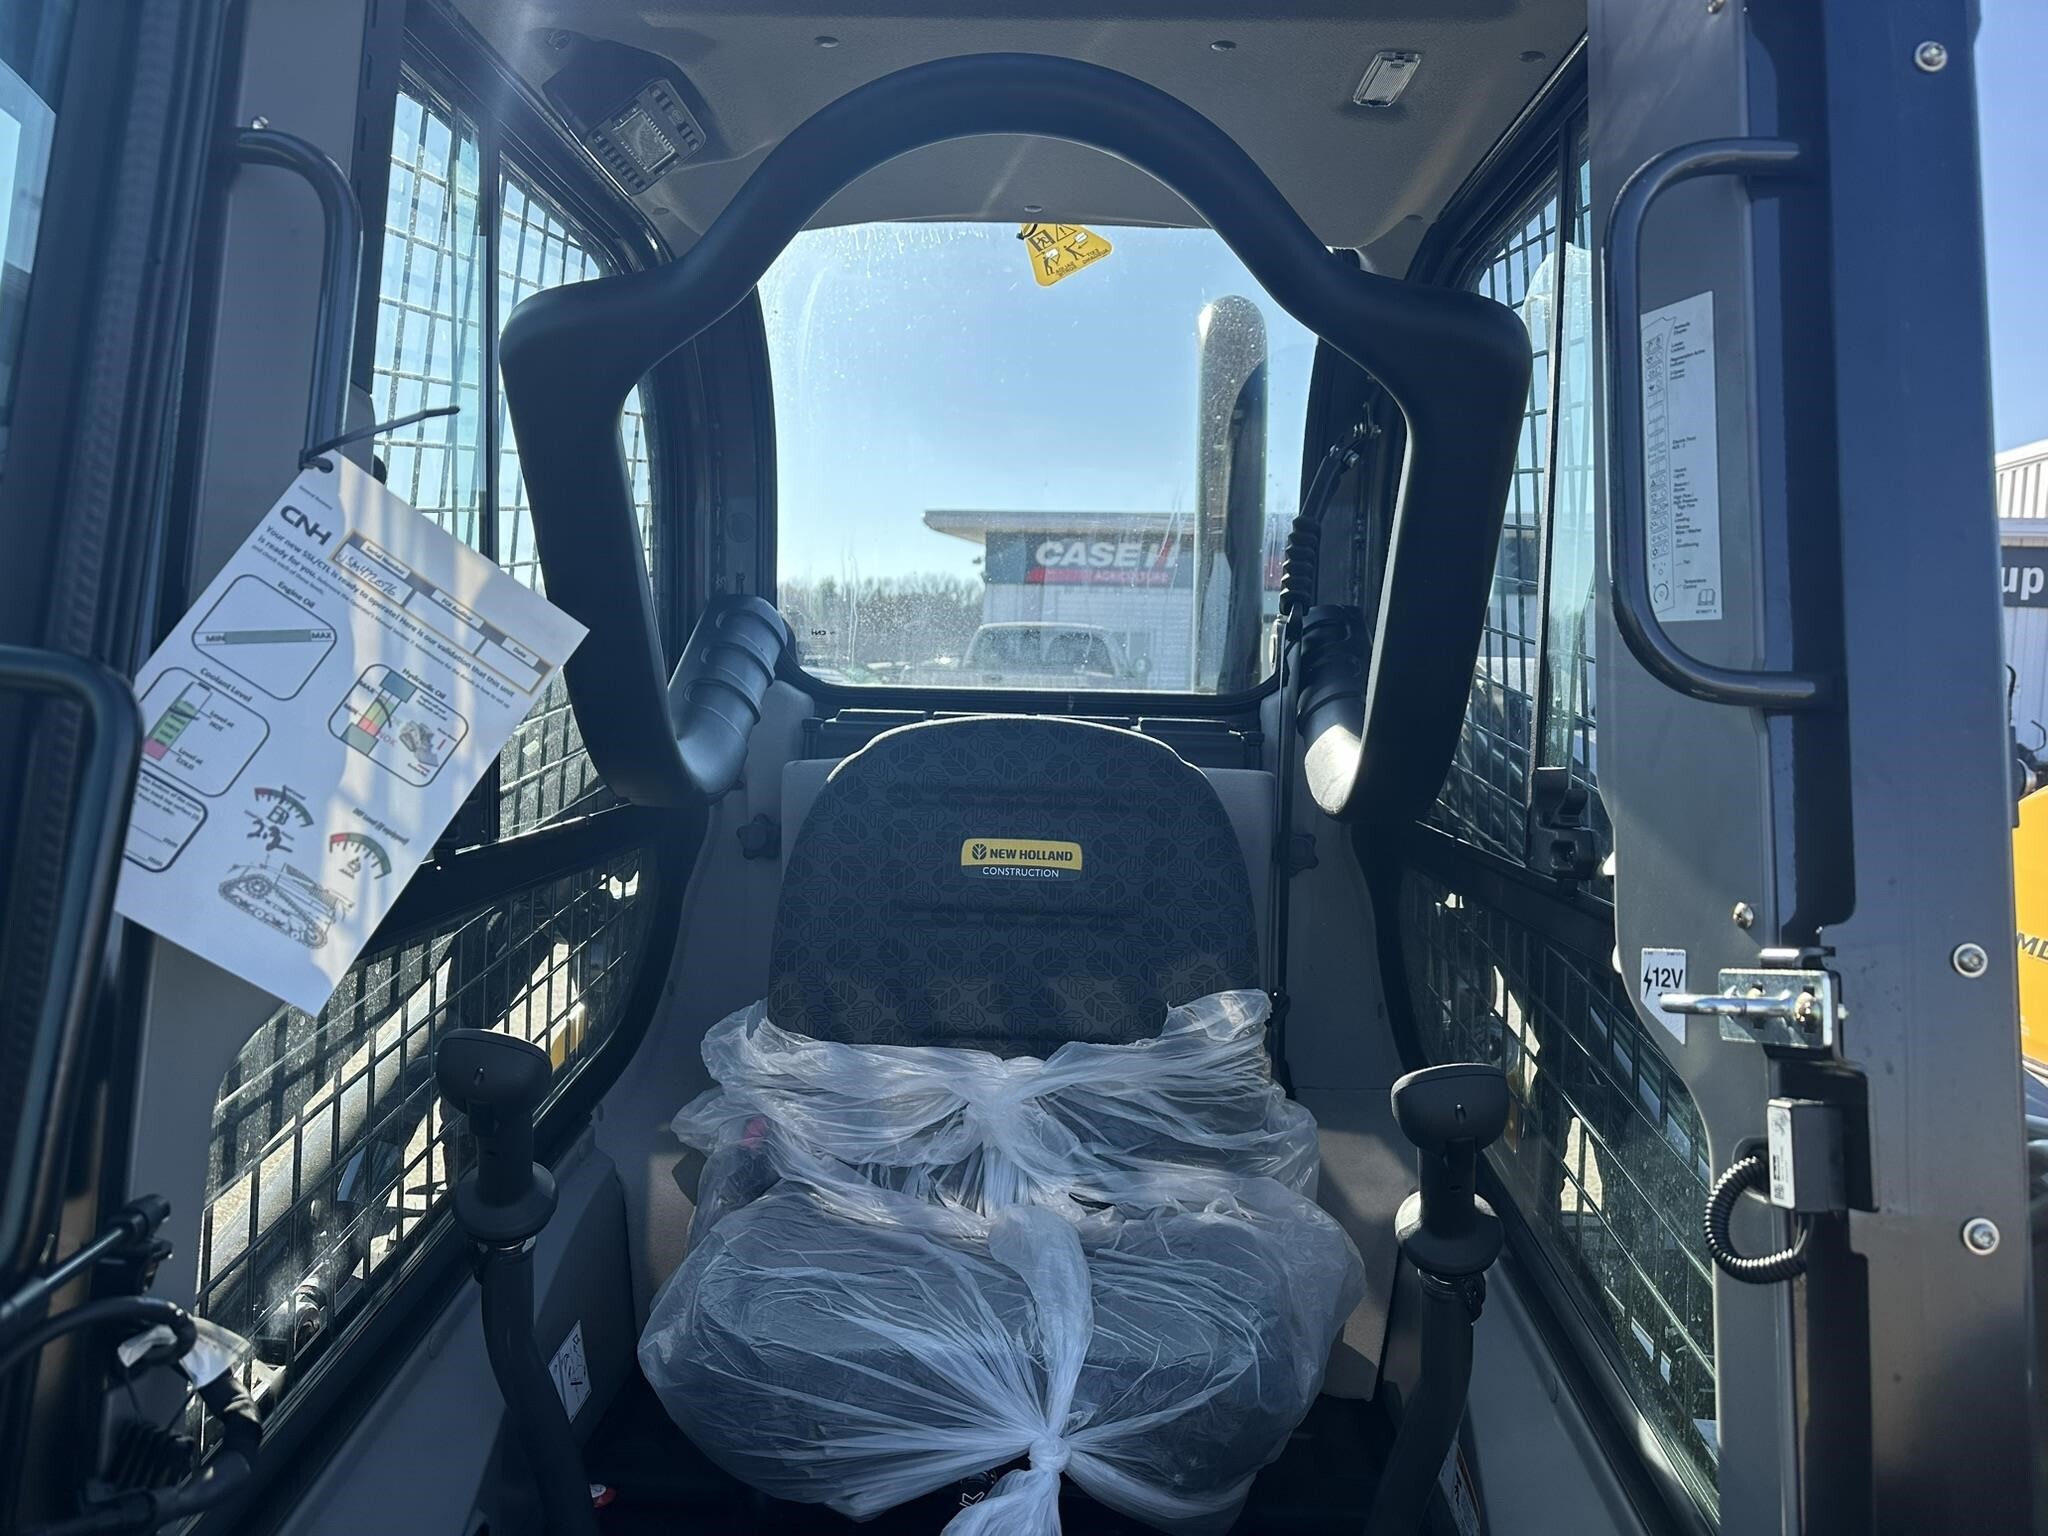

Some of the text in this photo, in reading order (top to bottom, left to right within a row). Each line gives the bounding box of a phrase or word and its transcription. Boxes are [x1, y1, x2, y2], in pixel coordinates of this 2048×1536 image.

[280, 505, 332, 546] CNH
[264, 541, 288, 561] ready
[288, 555, 301, 566] for
[1036, 542, 1142, 566] CASE
[278, 582, 316, 609] Engine Oil
[266, 526, 284, 541] Your
[283, 539, 301, 553] new
[336, 574, 359, 593] ready
[399, 616, 418, 632] Here
[423, 634, 437, 645] our
[436, 642, 473, 668] validation
[470, 665, 488, 678] that
[485, 675, 501, 687] this
[499, 684, 515, 696] unit
[206, 632, 332, 642] MIN MAX
[200, 668, 232, 691] Coolant
[230, 686, 253, 702] Level
[402, 668, 446, 700] Hydraulic Oil
[990, 848, 1073, 862] NEW HOLLAND
[982, 866, 1059, 878] CONSTRUCTION
[1653, 968, 1684, 988] 12V
